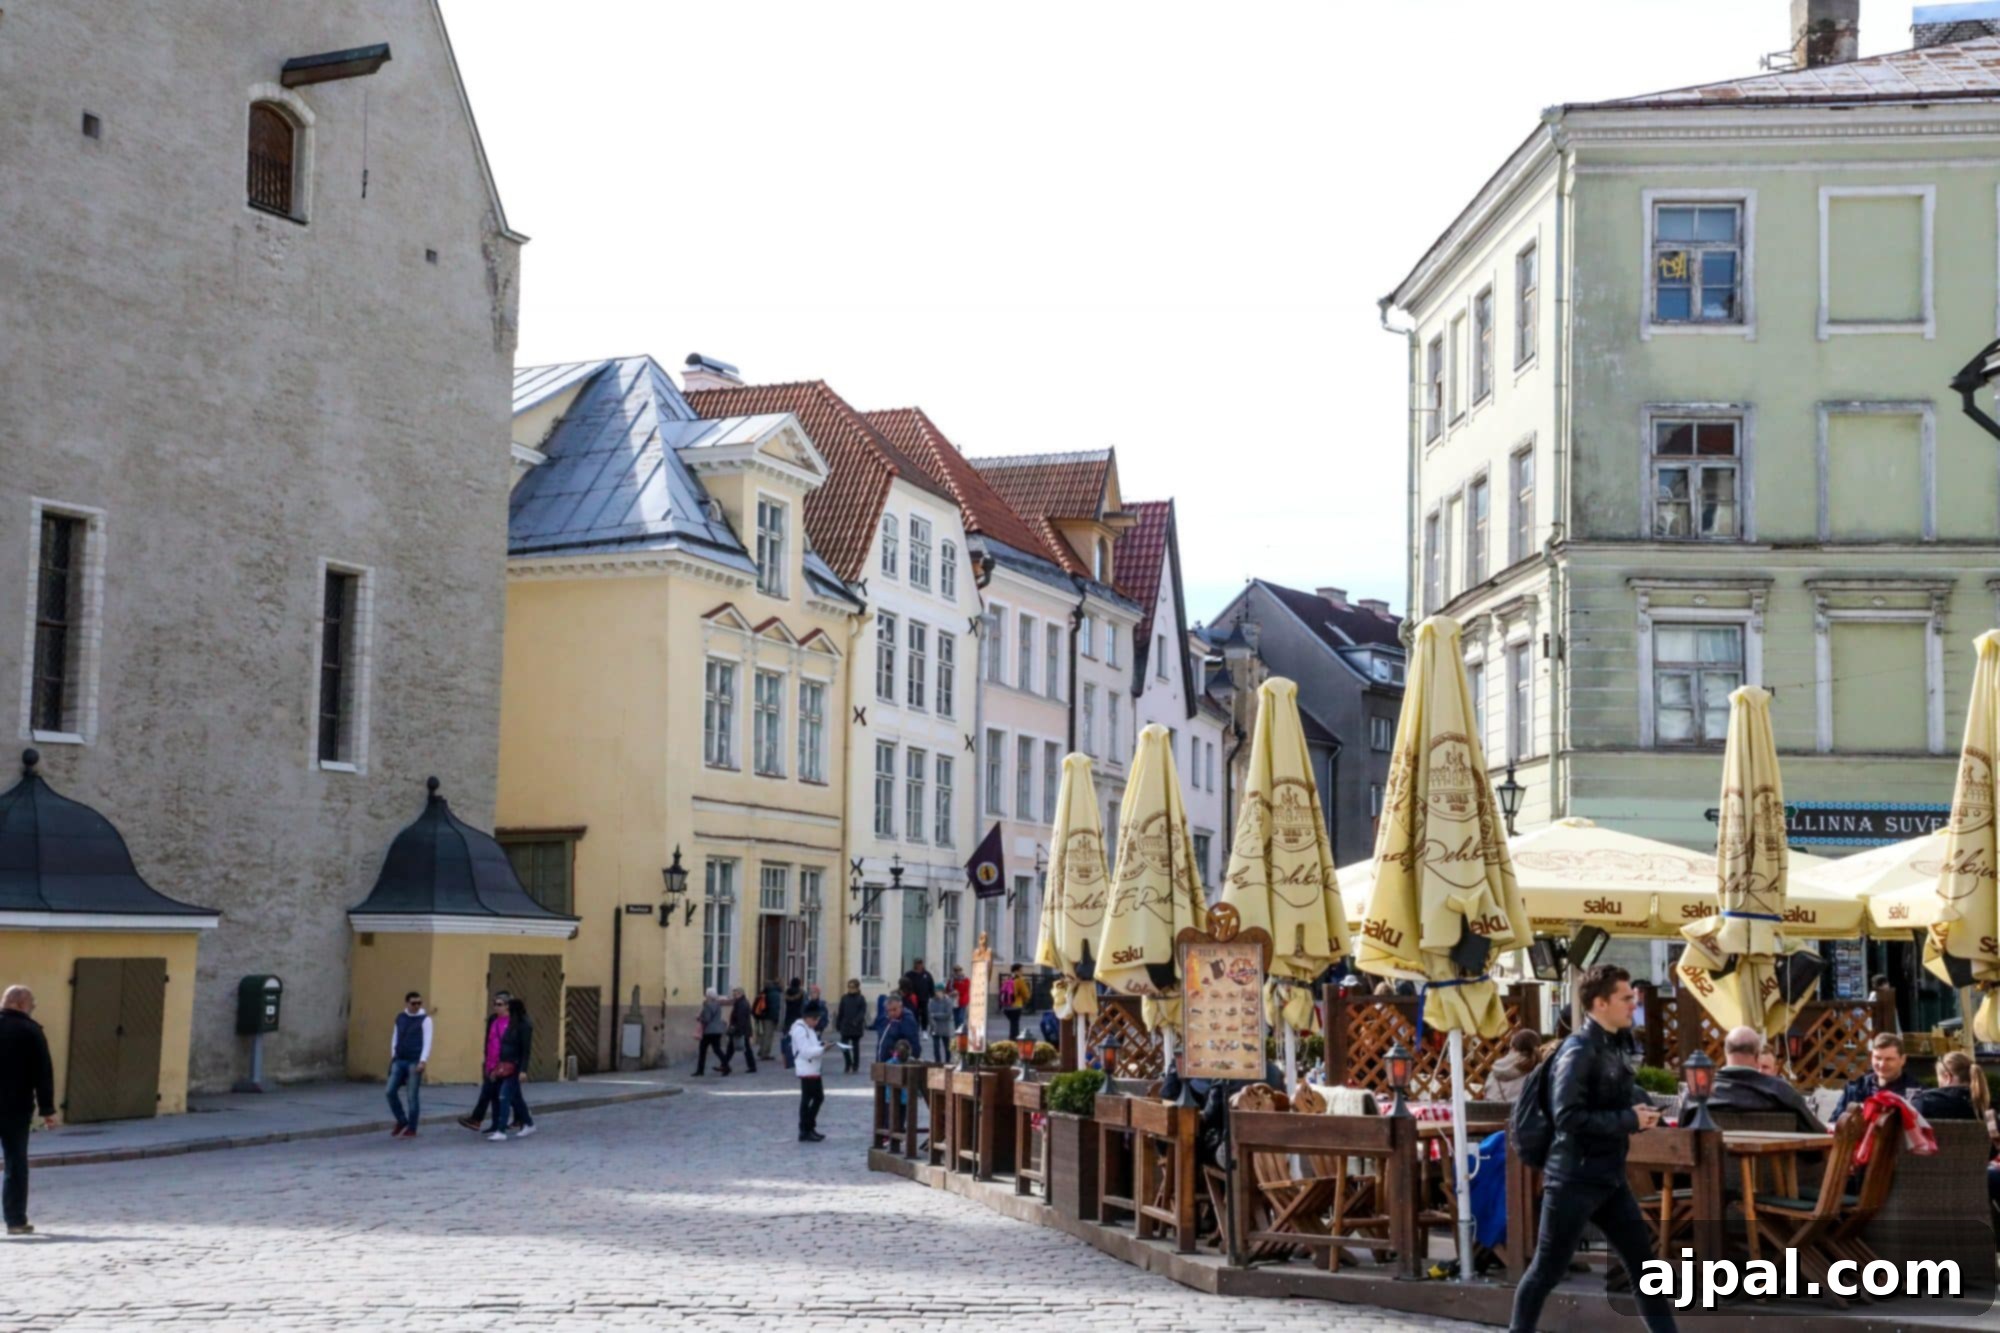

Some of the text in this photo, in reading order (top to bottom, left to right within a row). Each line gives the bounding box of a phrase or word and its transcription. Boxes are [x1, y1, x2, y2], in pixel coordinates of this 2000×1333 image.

[1785, 815, 1952, 834] LLINNA SUVE
[1584, 897, 1622, 915] saku
[1889, 904, 1909, 919] saku
[1112, 945, 1143, 964] saku
